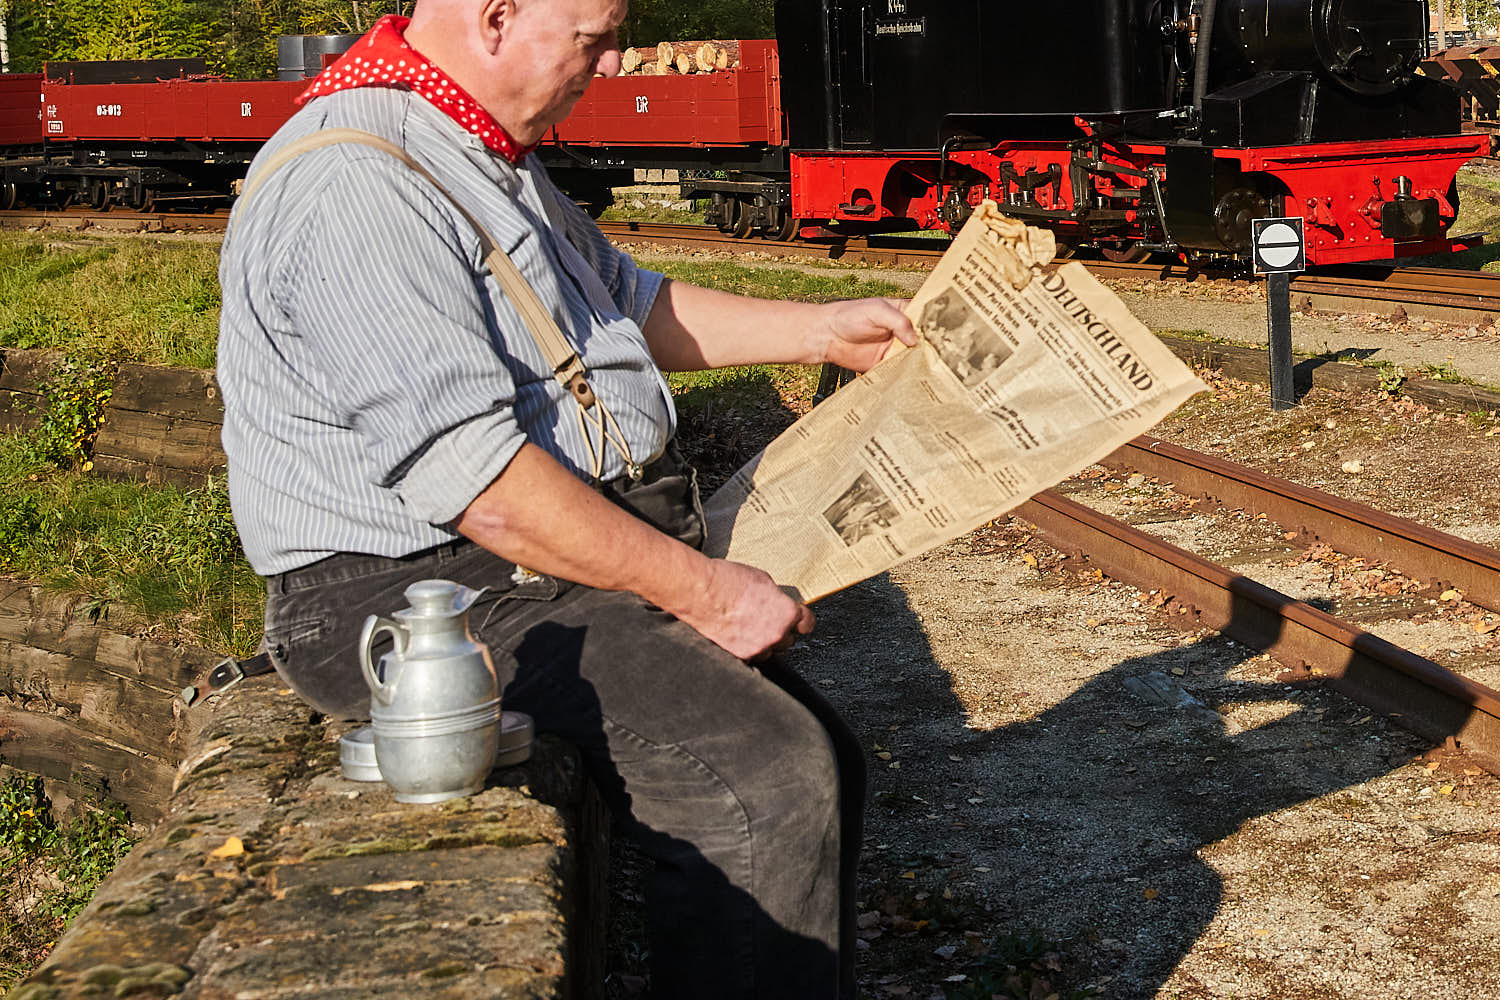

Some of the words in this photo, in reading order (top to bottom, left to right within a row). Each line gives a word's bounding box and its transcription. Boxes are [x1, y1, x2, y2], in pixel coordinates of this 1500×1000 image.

[887, 0, 894, 14] K
[241, 102, 252, 117] DR
[635, 95, 649, 113] DR
[1041, 270, 1153, 391] DEUTSCHLAND
